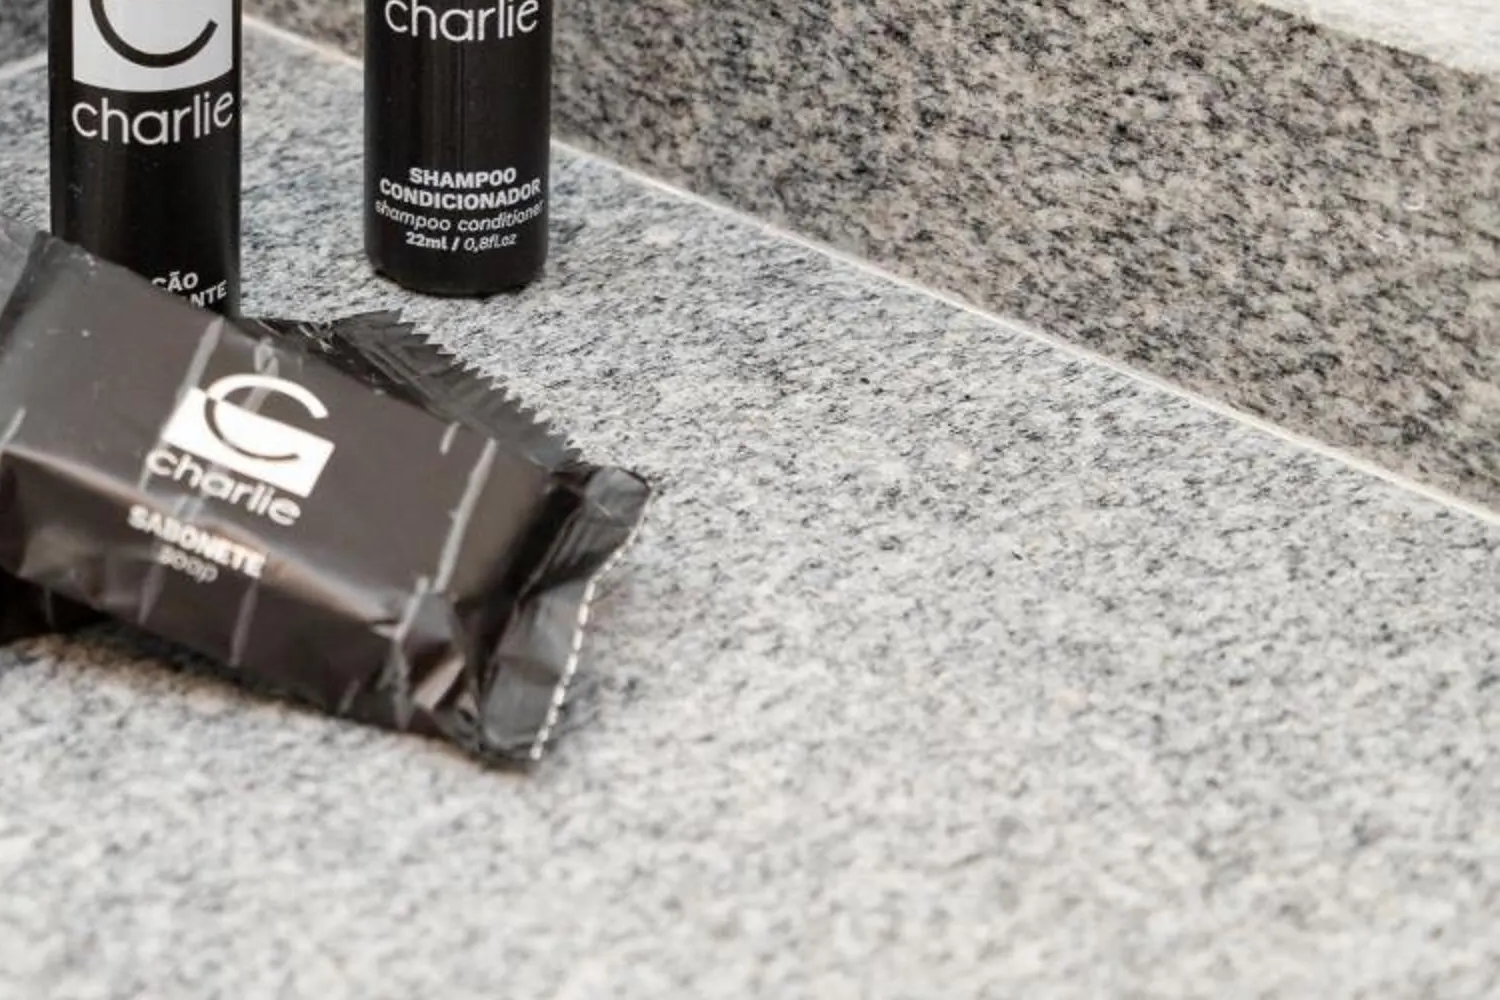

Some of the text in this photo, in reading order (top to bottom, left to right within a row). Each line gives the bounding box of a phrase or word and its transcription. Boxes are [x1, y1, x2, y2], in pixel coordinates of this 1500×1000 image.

[71, 91, 234, 146] charlie
[379, 178, 542, 210] CONDICIONADOR
[408, 166, 517, 189] SHAMPOO
[374, 199, 545, 232] shampoo conditioner
[405, 231, 449, 251] 22ml
[451, 236, 461, 252] /
[145, 448, 302, 526] charlie
[127, 502, 268, 580] SABONETE
[158, 546, 219, 583] soap
